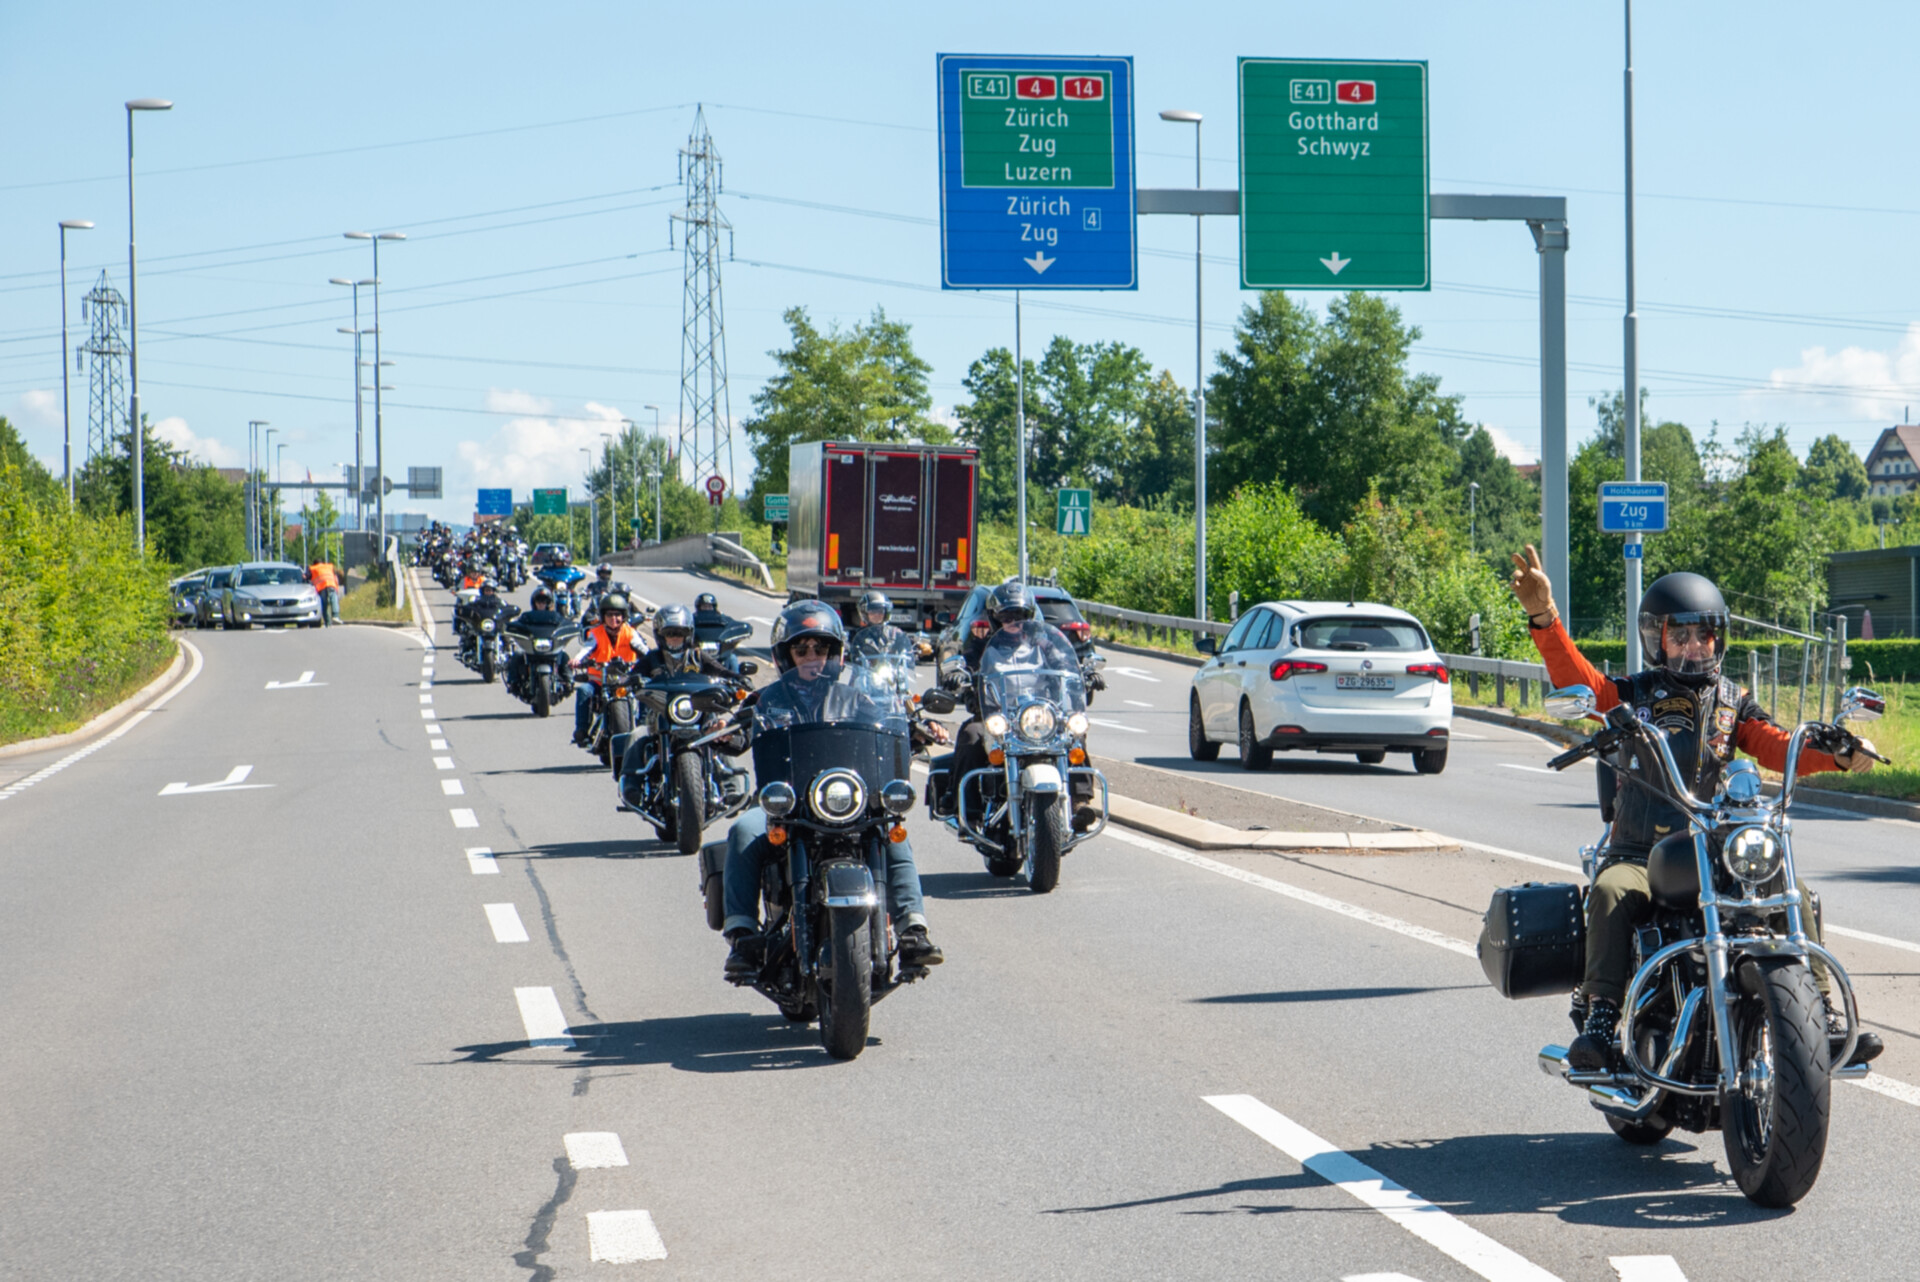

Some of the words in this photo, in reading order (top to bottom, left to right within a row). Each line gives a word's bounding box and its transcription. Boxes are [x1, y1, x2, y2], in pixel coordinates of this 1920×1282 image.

[974, 79, 1004, 95] E41
[1030, 79, 1041, 95] 4
[1073, 80, 1094, 96] 14
[1294, 84, 1323, 100] E41
[1350, 84, 1361, 100] 4
[1005, 107, 1069, 127] Zürich
[1288, 111, 1378, 131] Gotthard
[1019, 134, 1056, 158] Zug
[1297, 136, 1370, 160] Schwyz
[1005, 162, 1071, 181] Luzern
[1007, 195, 1070, 216] Zürich
[1087, 212, 1097, 227] 4
[1021, 223, 1058, 246] Zug
[1610, 487, 1657, 495] Holzhäusern
[1620, 503, 1648, 521] Zug
[1631, 520, 1644, 528] km
[1629, 545, 1637, 557] 4
